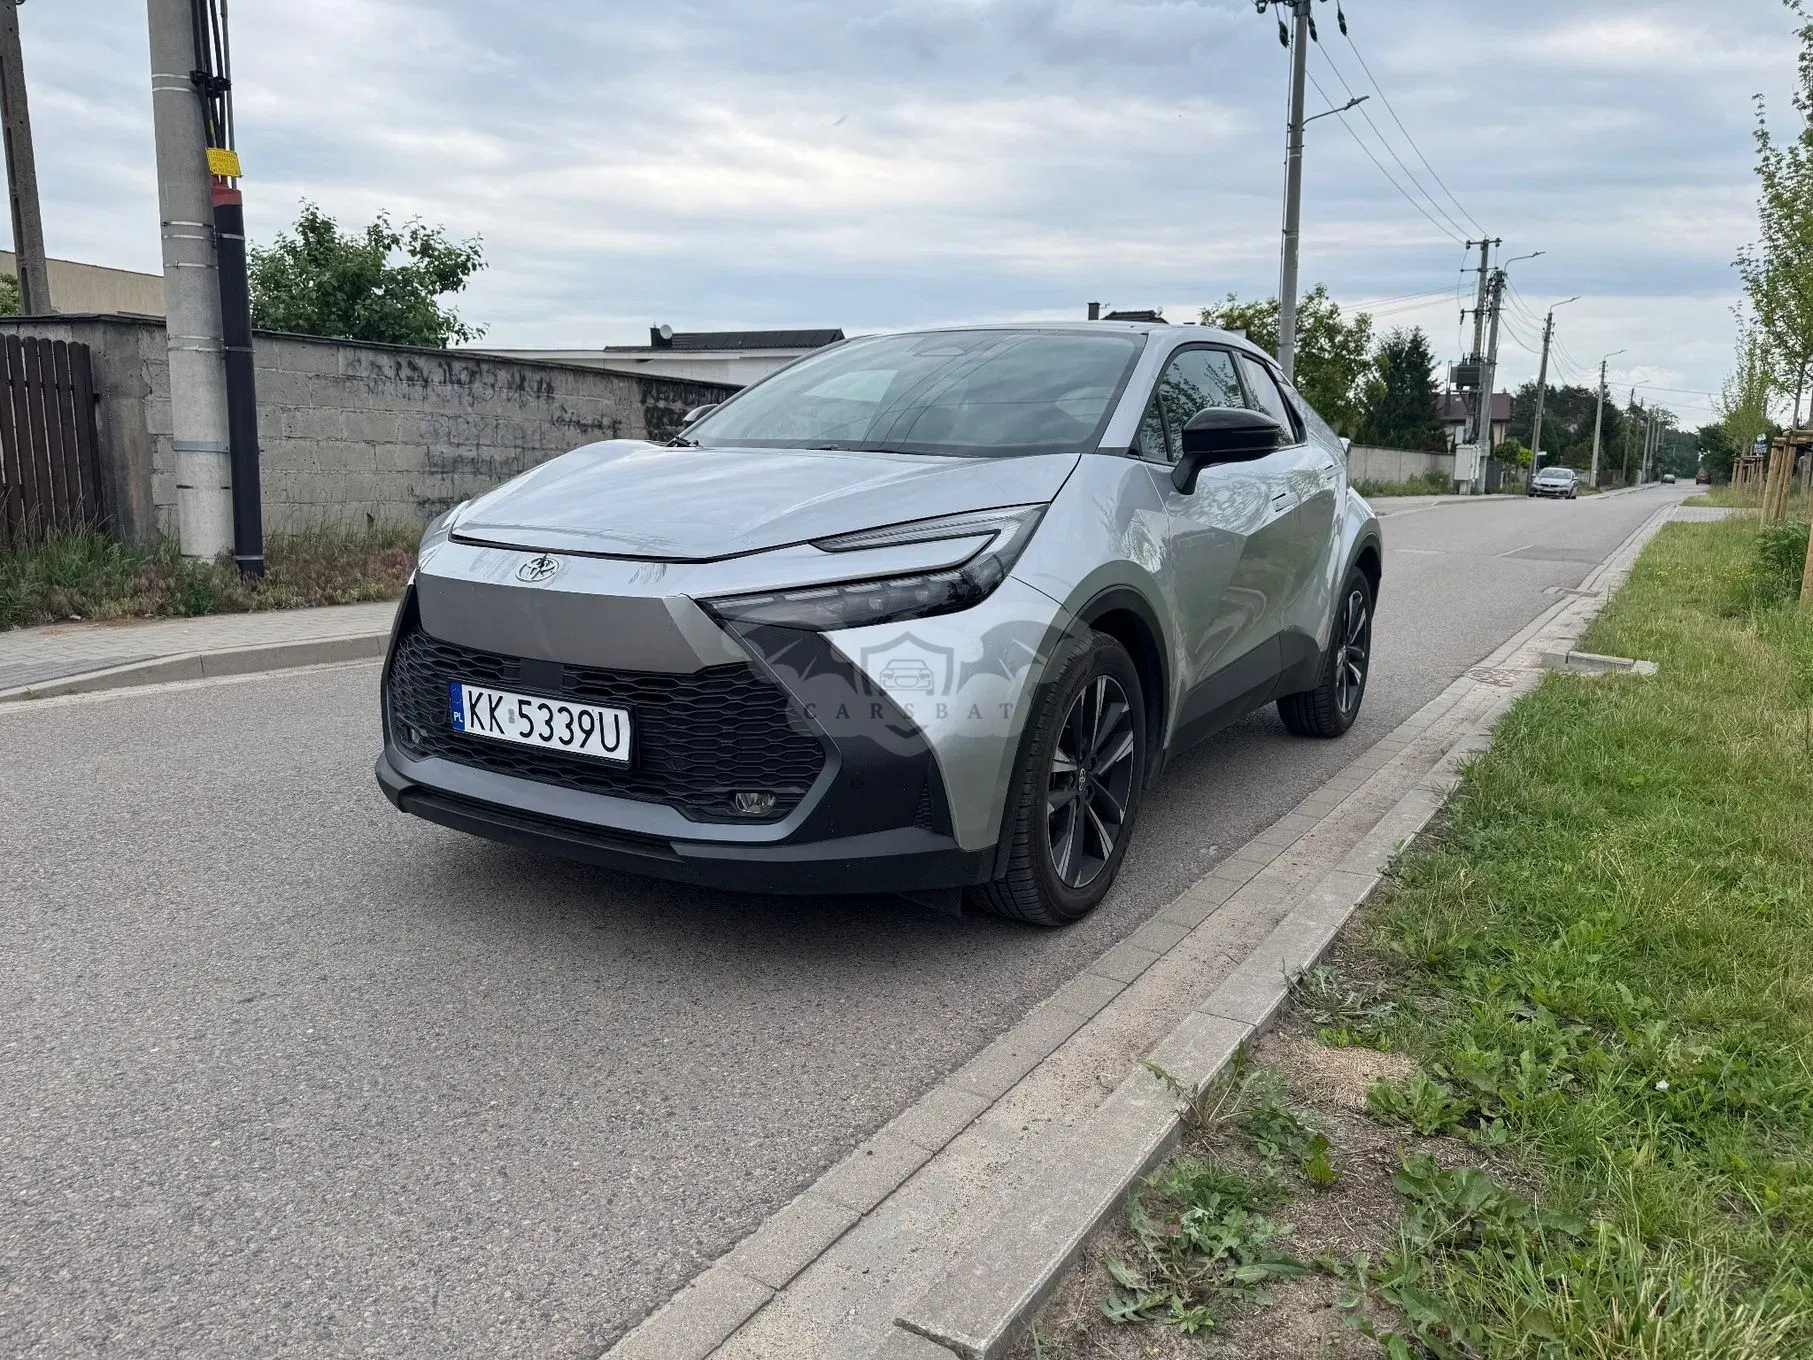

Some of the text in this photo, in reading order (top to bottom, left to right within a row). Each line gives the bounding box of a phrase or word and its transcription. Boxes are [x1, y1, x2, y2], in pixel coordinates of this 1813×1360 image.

[454, 711, 464, 723] PL
[468, 690, 620, 752] KK 5339U
